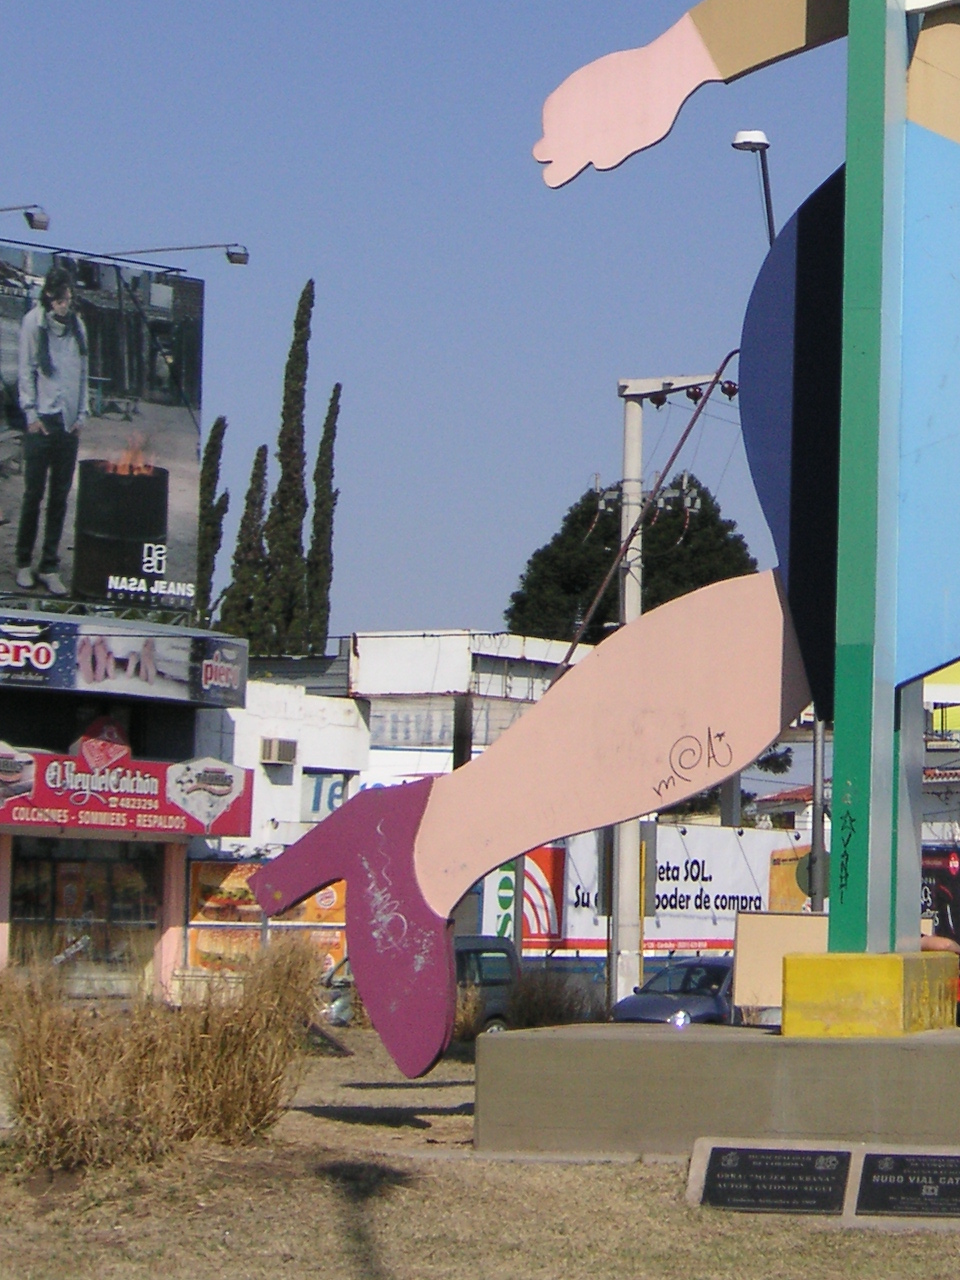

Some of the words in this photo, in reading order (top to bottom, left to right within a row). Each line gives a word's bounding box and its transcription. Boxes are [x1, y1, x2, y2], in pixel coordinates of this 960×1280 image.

[149, 580, 196, 598] JEANS
[202, 650, 240, 690] piero
[109, 767, 159, 796] Colchón
[136, 814, 187, 830] RESPALDOS
[683, 858, 713, 883] SOL.
[574, 884, 590, 908] Su
[694, 888, 711, 911] de
[714, 894, 762, 911] compra
[908, 1175, 934, 1184] VIAL
